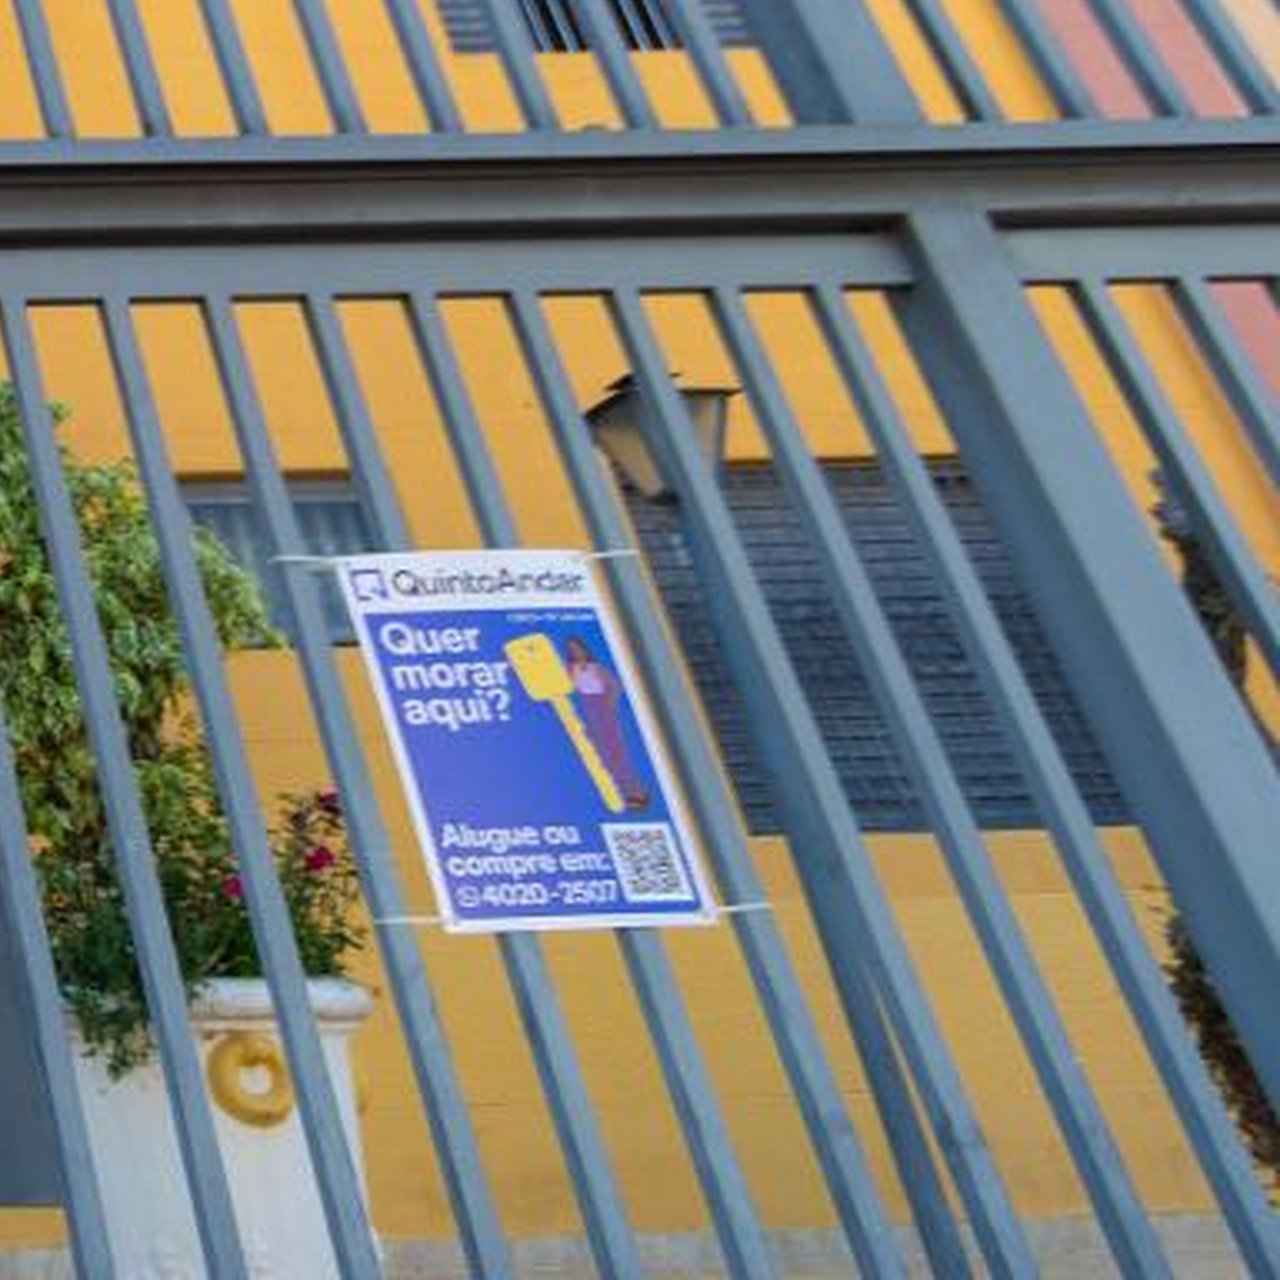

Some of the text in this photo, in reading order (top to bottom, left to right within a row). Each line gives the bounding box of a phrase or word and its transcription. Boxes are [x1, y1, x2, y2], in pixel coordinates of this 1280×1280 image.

[393, 568, 583, 596] QuintoAndar
[381, 622, 480, 654] Quer
[391, 661, 508, 690] morar
[403, 688, 510, 732] aqui?
[441, 823, 581, 853] Alugue ou
[448, 852, 612, 879] compre em:
